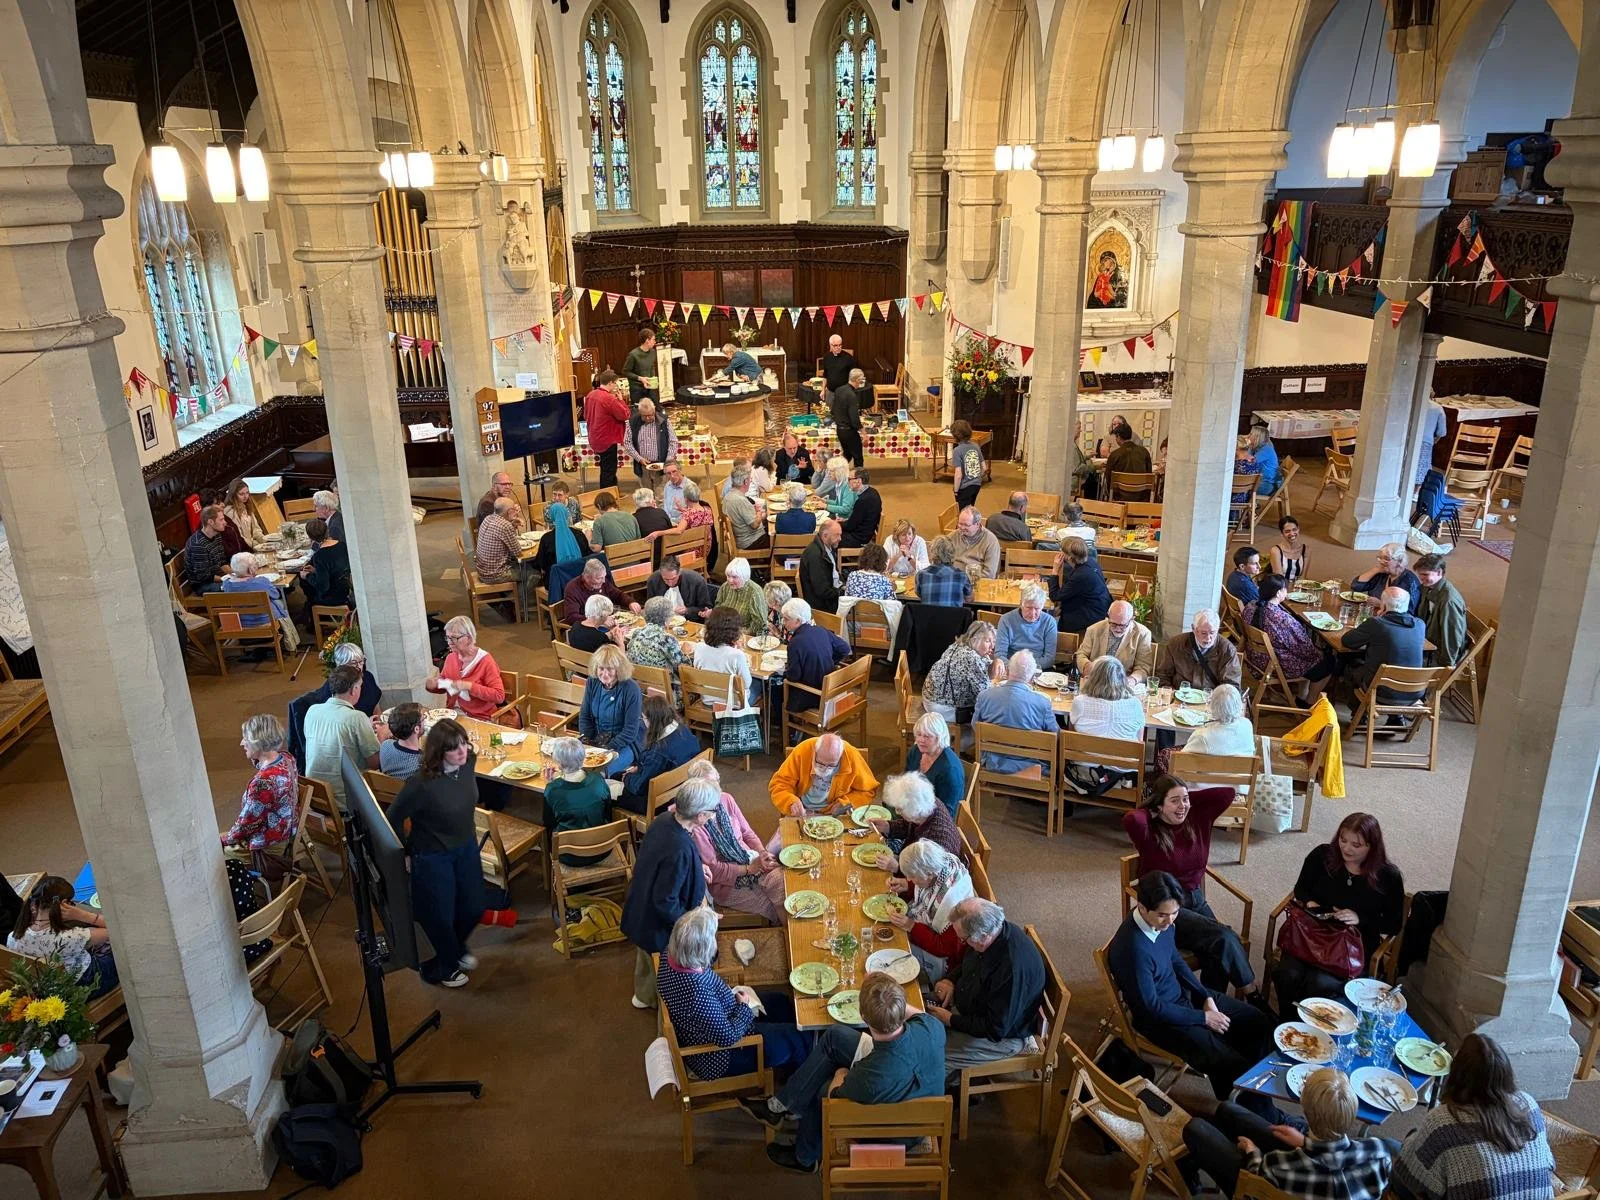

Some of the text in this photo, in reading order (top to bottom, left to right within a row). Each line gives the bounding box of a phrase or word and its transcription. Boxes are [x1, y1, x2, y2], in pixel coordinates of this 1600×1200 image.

[482, 401, 494, 411] 97
[487, 412, 493, 421] 8
[487, 432, 498, 442] 67
[485, 442, 500, 453] 541
